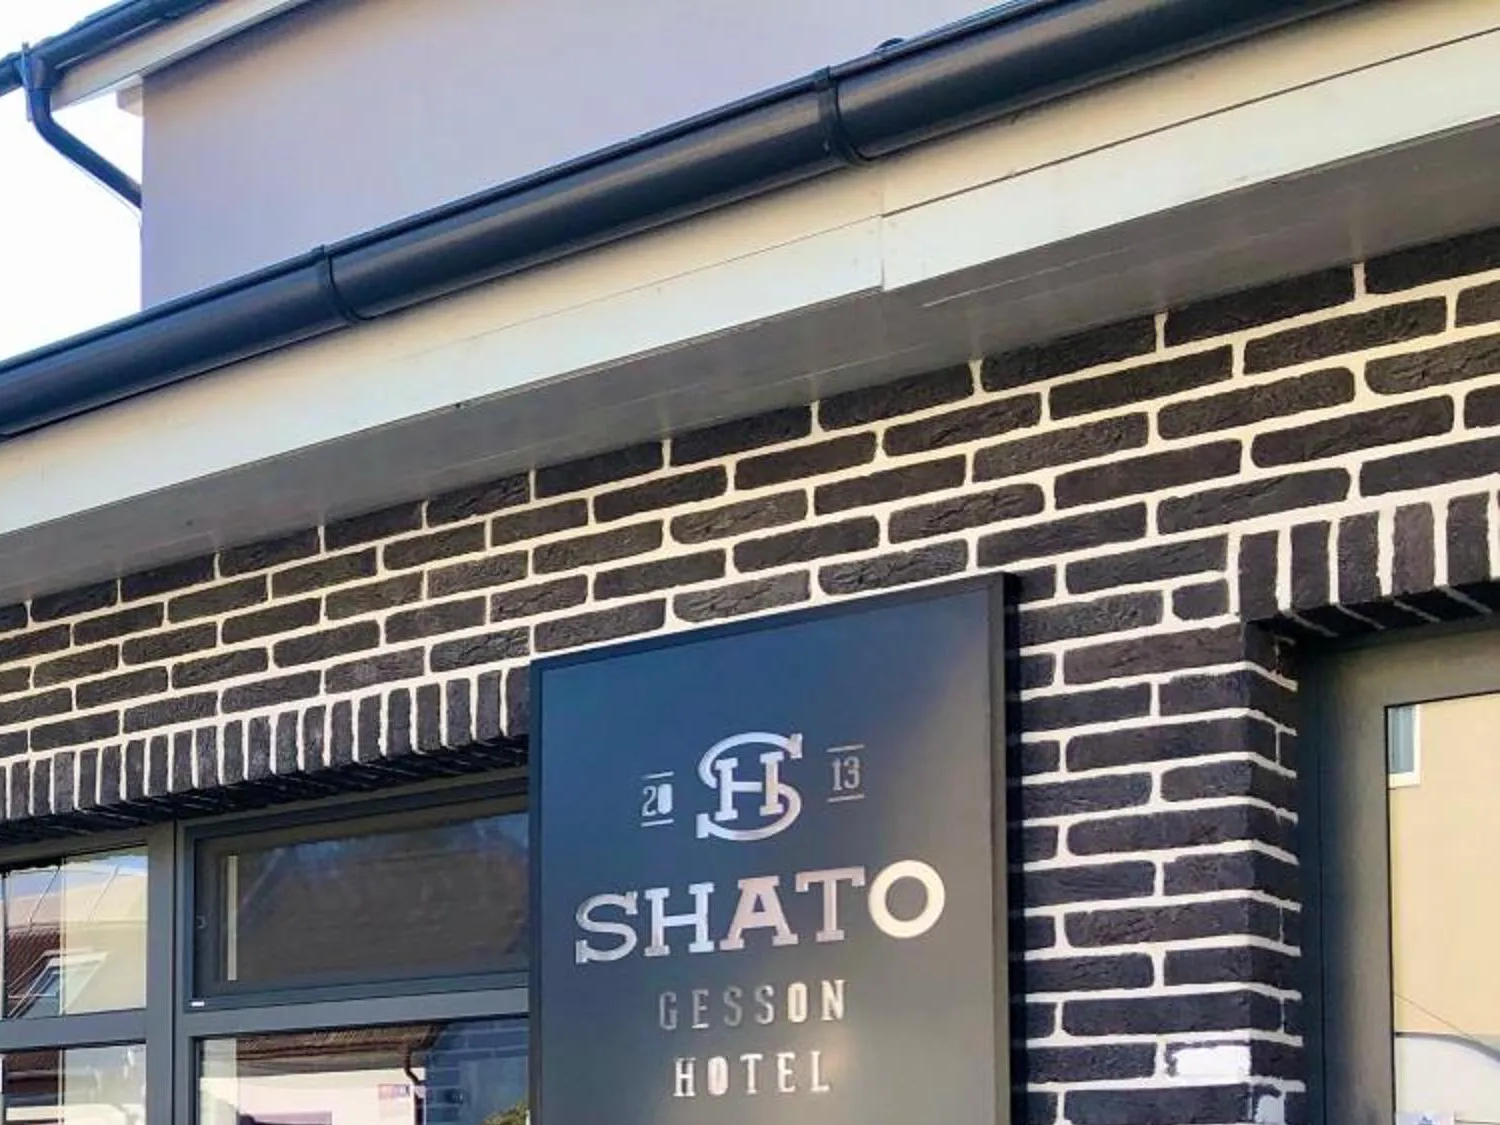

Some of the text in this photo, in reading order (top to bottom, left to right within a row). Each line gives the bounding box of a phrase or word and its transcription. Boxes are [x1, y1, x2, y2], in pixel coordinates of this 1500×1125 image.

[641, 783, 673, 816] 20
[831, 755, 861, 792] 13
[575, 859, 946, 964] SHATO
[659, 979, 847, 1030] GESSON
[673, 1050, 831, 1097] HOTEL
